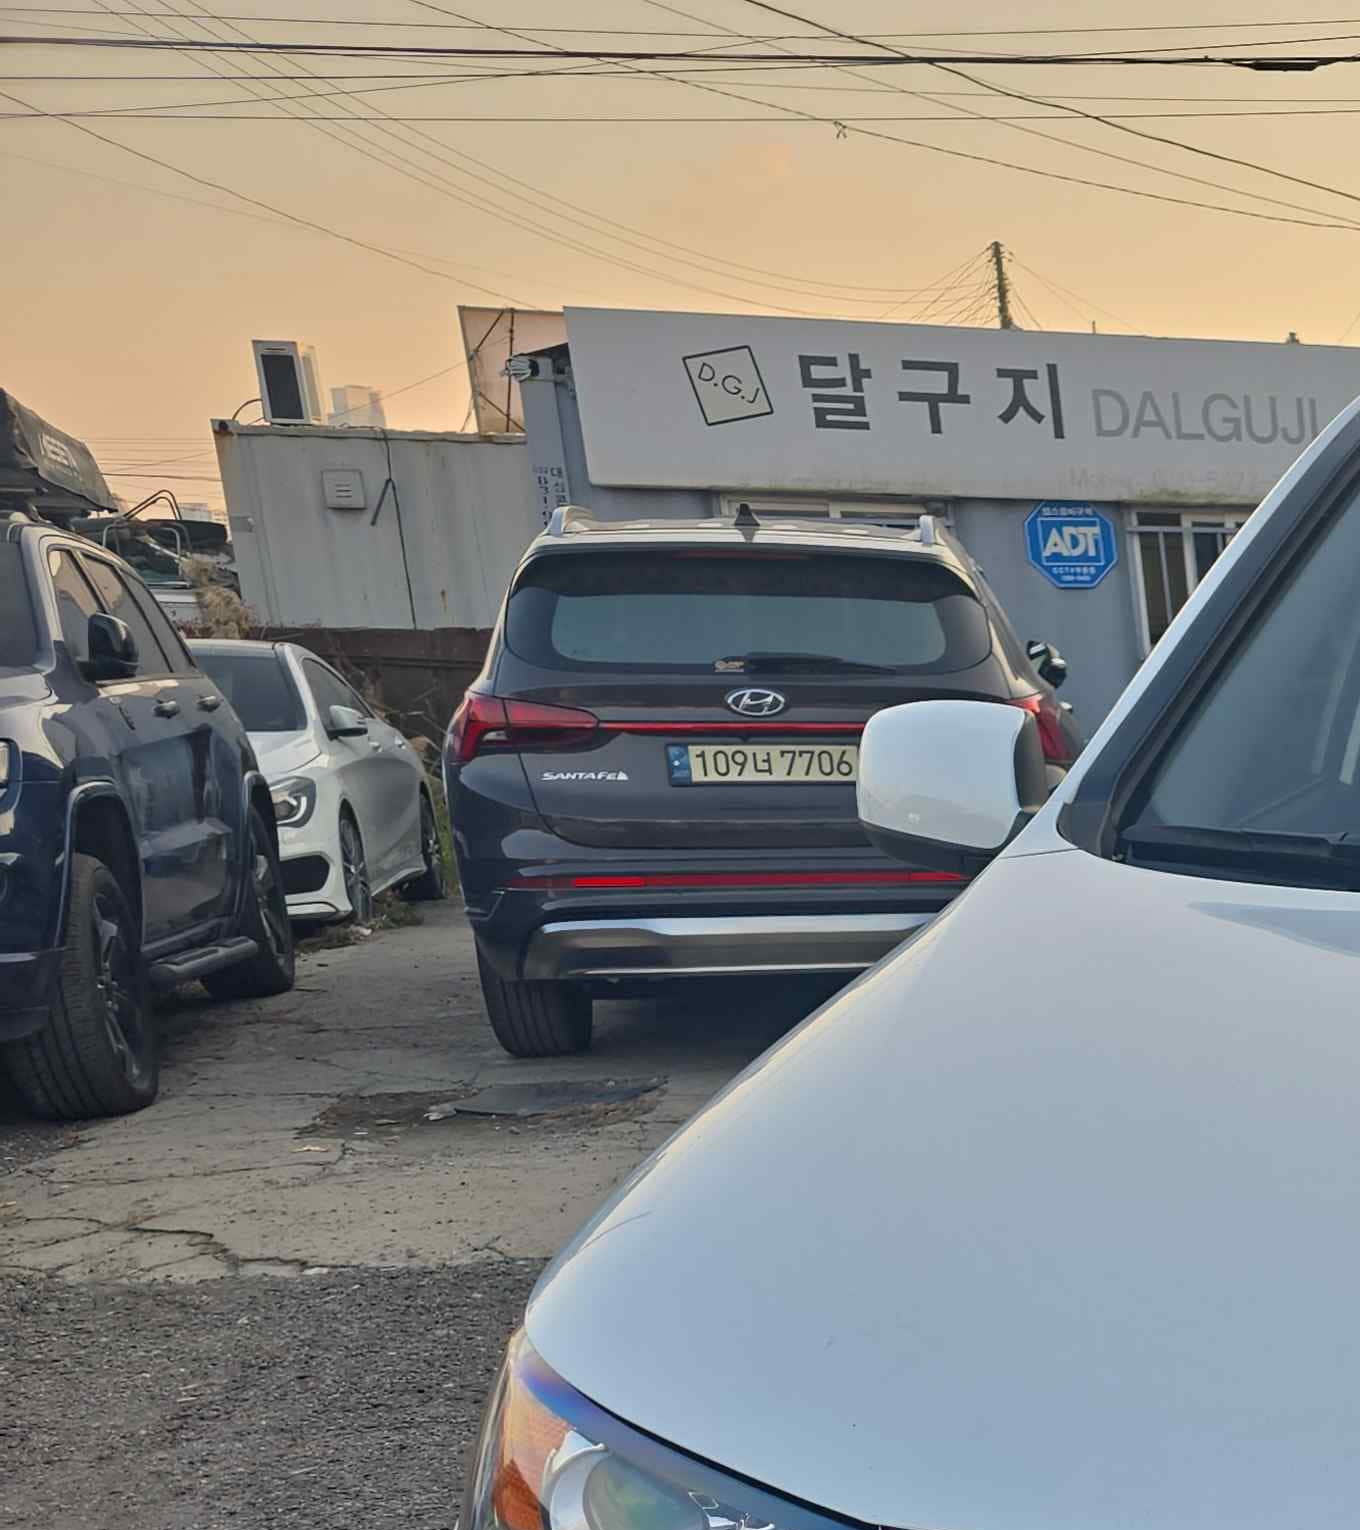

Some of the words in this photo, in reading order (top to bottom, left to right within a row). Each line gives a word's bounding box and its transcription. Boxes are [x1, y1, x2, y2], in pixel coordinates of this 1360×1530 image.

[797, 352, 1066, 440] 달구지
[1090, 387, 1321, 446] DALGUJI
[1042, 526, 1100, 557] ADT
[695, 749, 774, 778] 109너
[780, 749, 854, 778] 7706
